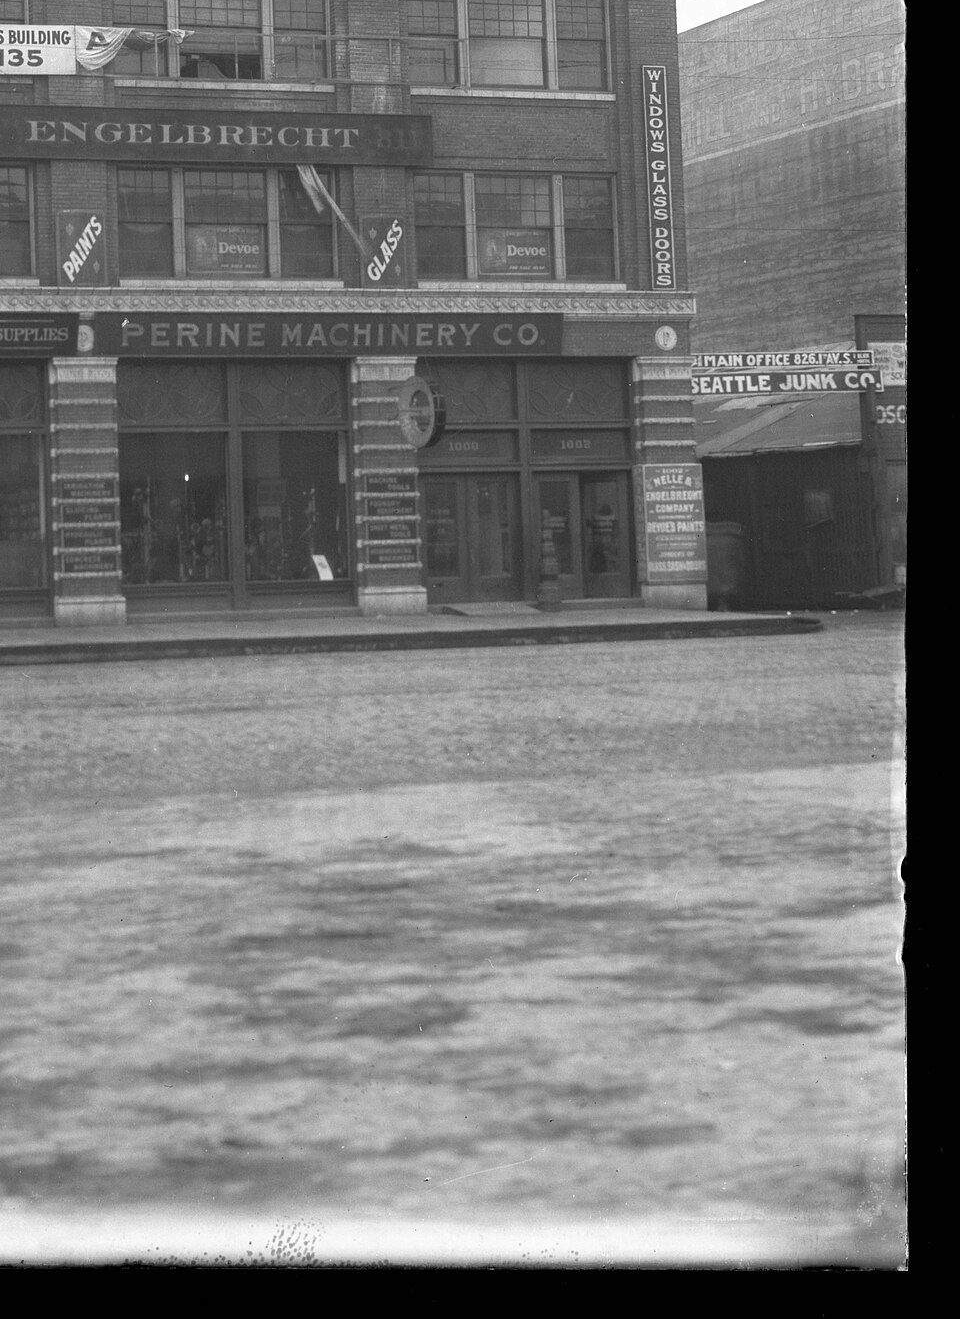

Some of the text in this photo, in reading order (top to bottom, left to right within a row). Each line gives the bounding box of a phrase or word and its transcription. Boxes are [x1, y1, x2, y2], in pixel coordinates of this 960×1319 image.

[7, 29, 73, 47] BUILDING
[25, 119, 361, 149] ENGELBRECHT
[646, 69, 673, 287] WINDOWS GLASS DOORS
[62, 215, 103, 283] PAINTS
[218, 241, 261, 255] Devoe
[367, 219, 404, 282] GLASS
[506, 243, 548, 257] Devoe
[120, 321, 546, 349] PERINE MACHINERY CO.
[703, 354, 744, 367] MAIN
[746, 353, 790, 367] OFFICE
[691, 371, 882, 394] SEATTLE JUNK CO.
[559, 439, 592, 451] 1002
[653, 473, 693, 488] NELLE &
[645, 490, 703, 502] ENGELBRECHT
[655, 503, 695, 513] COMPANY
